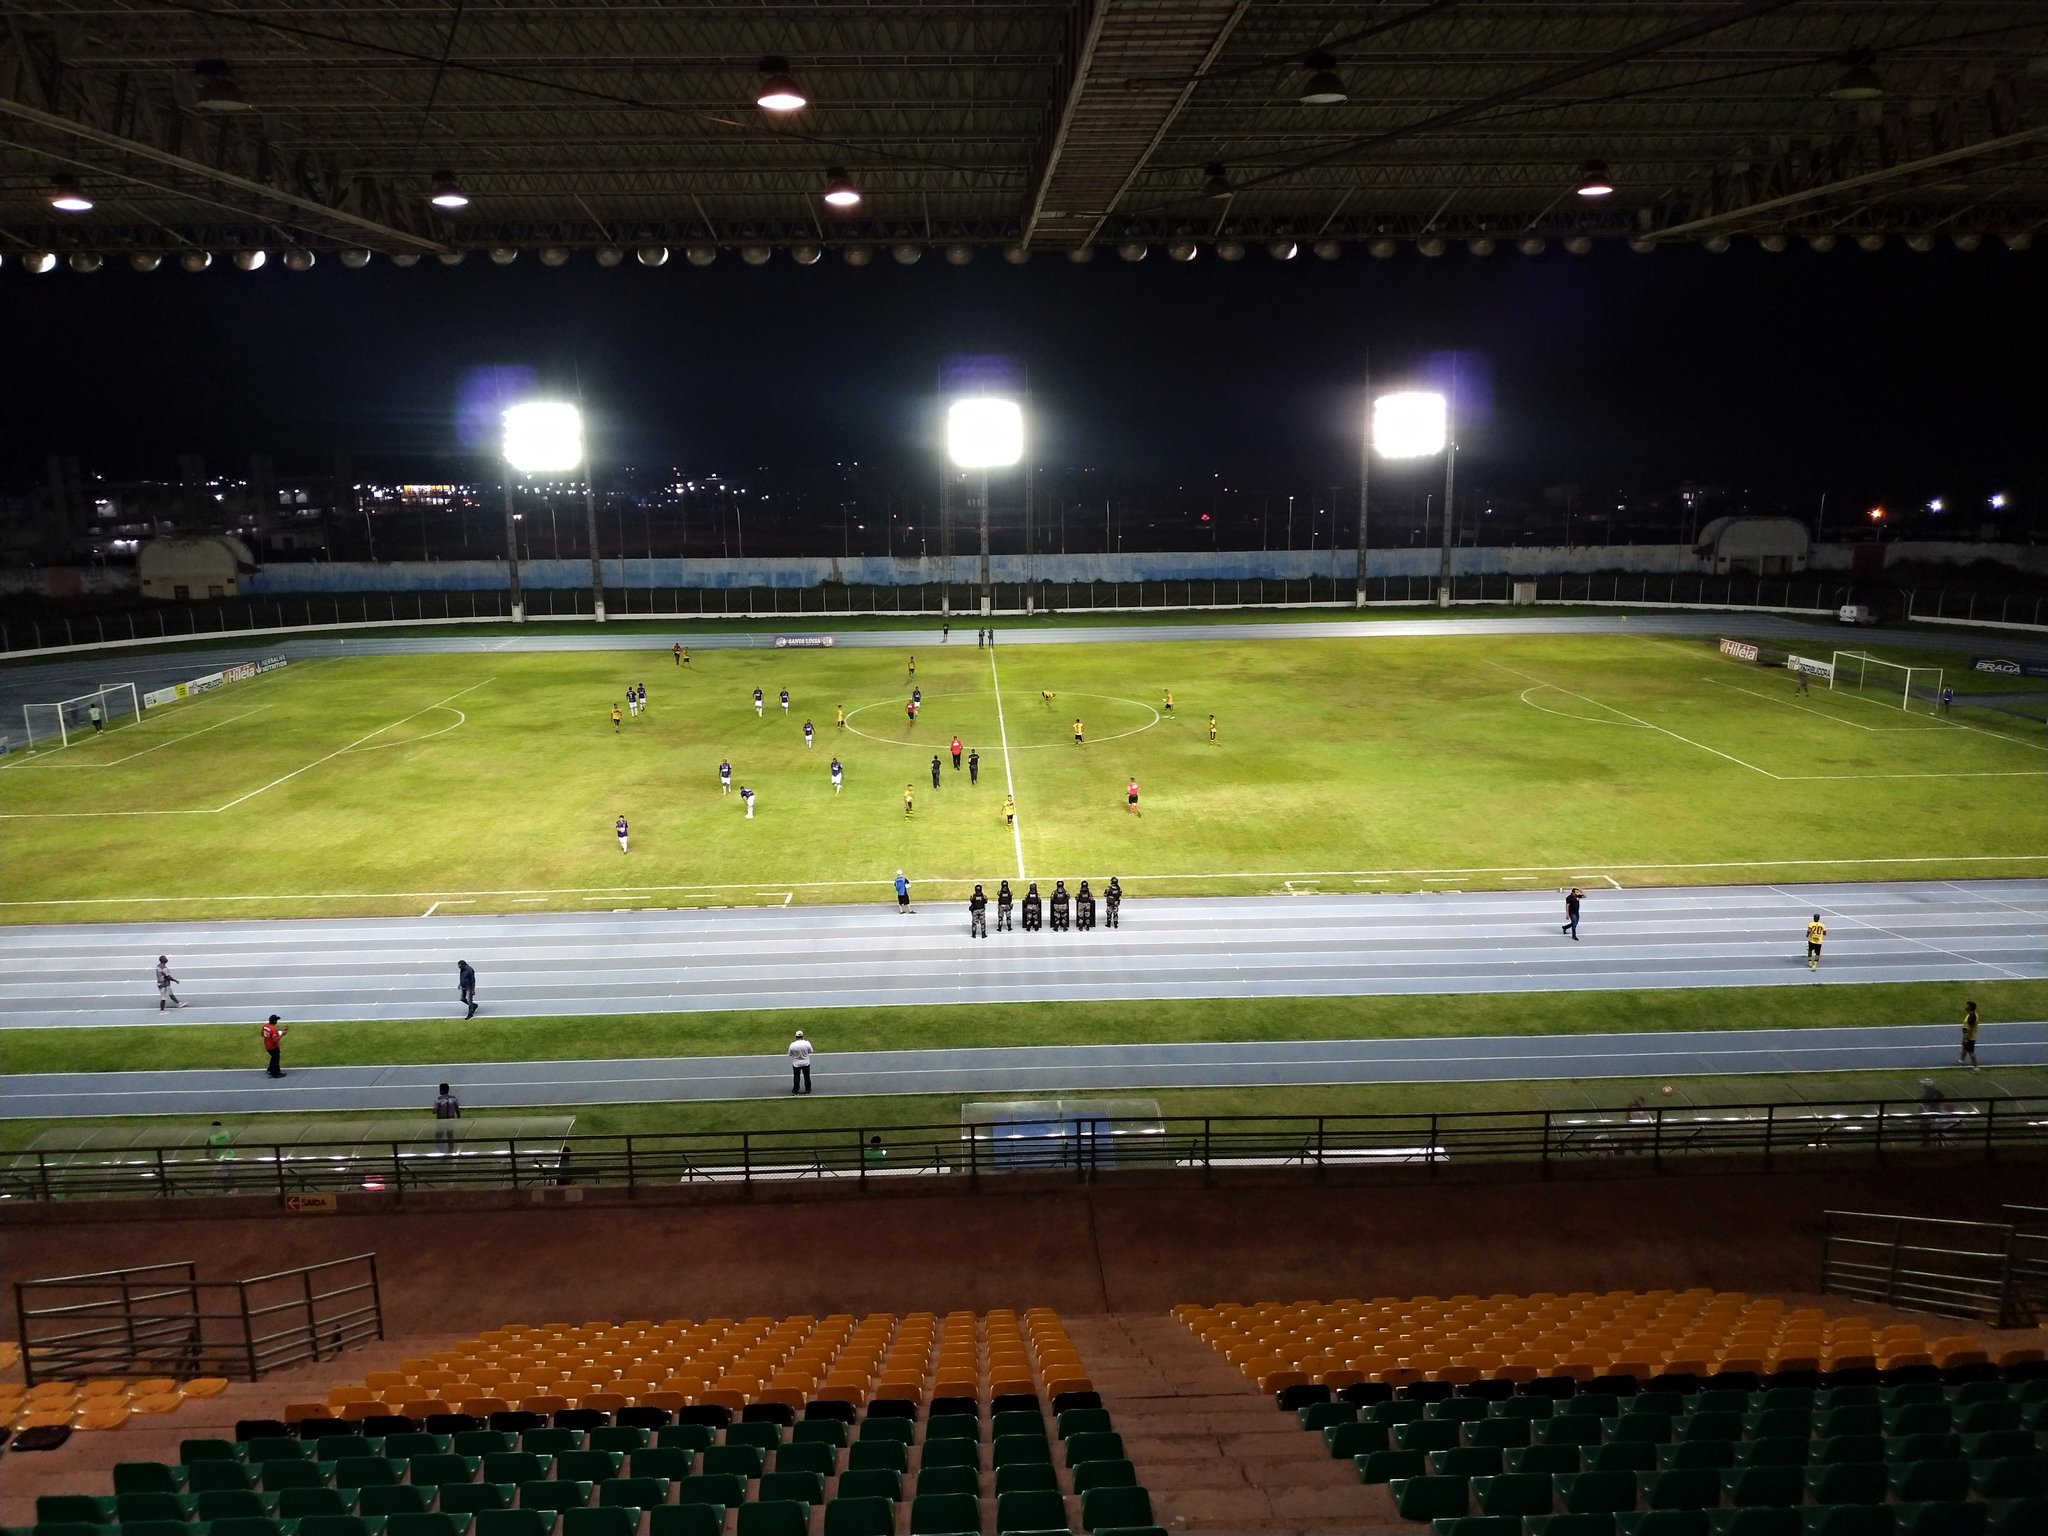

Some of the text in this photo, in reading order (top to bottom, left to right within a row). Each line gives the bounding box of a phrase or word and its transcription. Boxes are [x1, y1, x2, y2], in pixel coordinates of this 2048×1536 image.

[1725, 641, 1756, 661] Hiléia
[228, 665, 255, 684] Hiléia
[1975, 662, 2021, 674] BRAGA
[1811, 925, 1823, 935] 20
